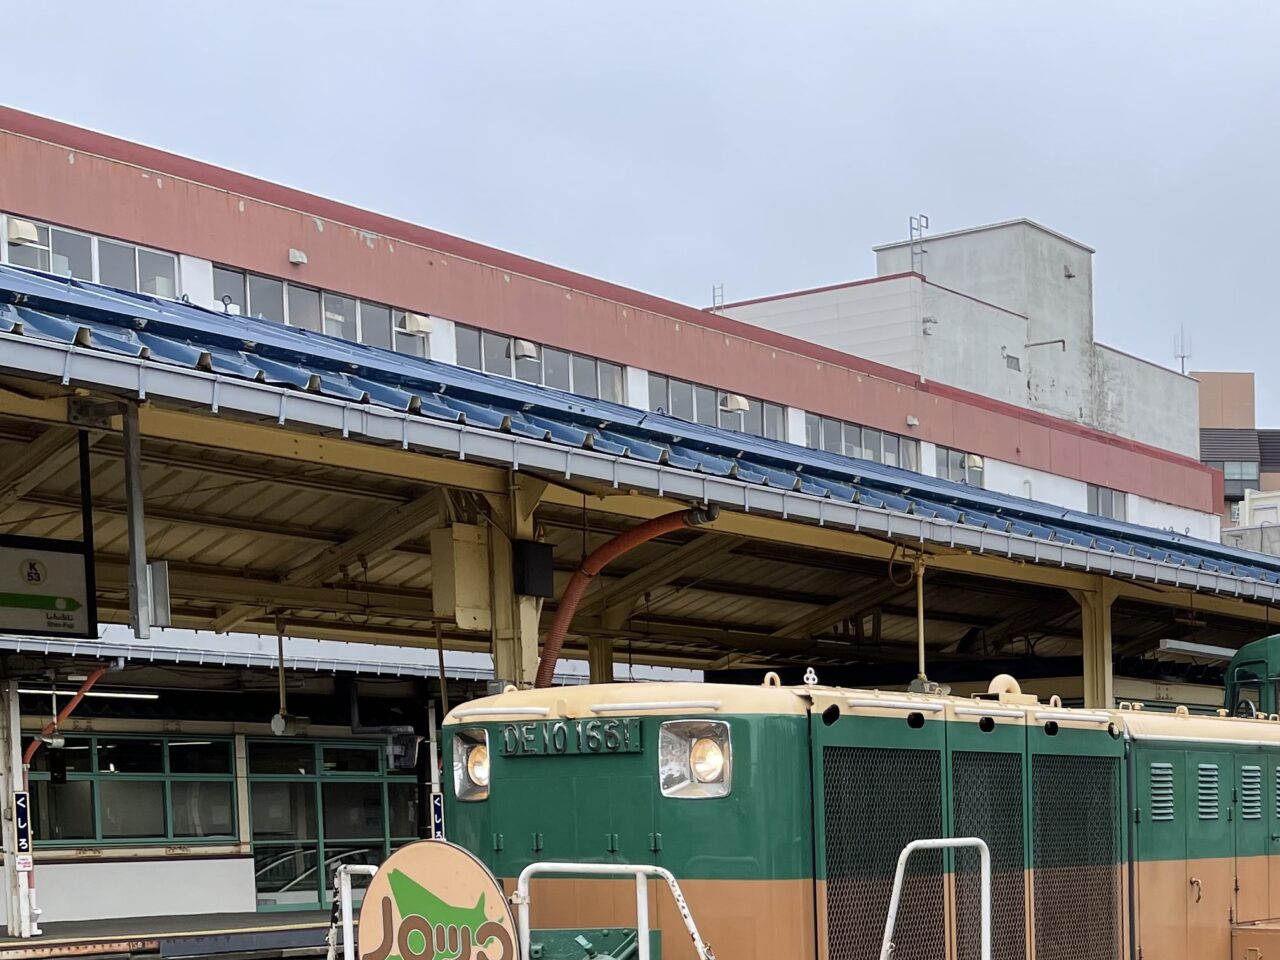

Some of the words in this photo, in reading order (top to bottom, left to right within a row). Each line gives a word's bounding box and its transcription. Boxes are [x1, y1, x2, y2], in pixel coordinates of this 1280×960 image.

[27, 572, 41, 582] 53
[29, 562, 38, 572] K
[504, 720, 568, 756] DE10
[575, 718, 630, 753] 1661
[17, 797, 29, 850] くしろ
